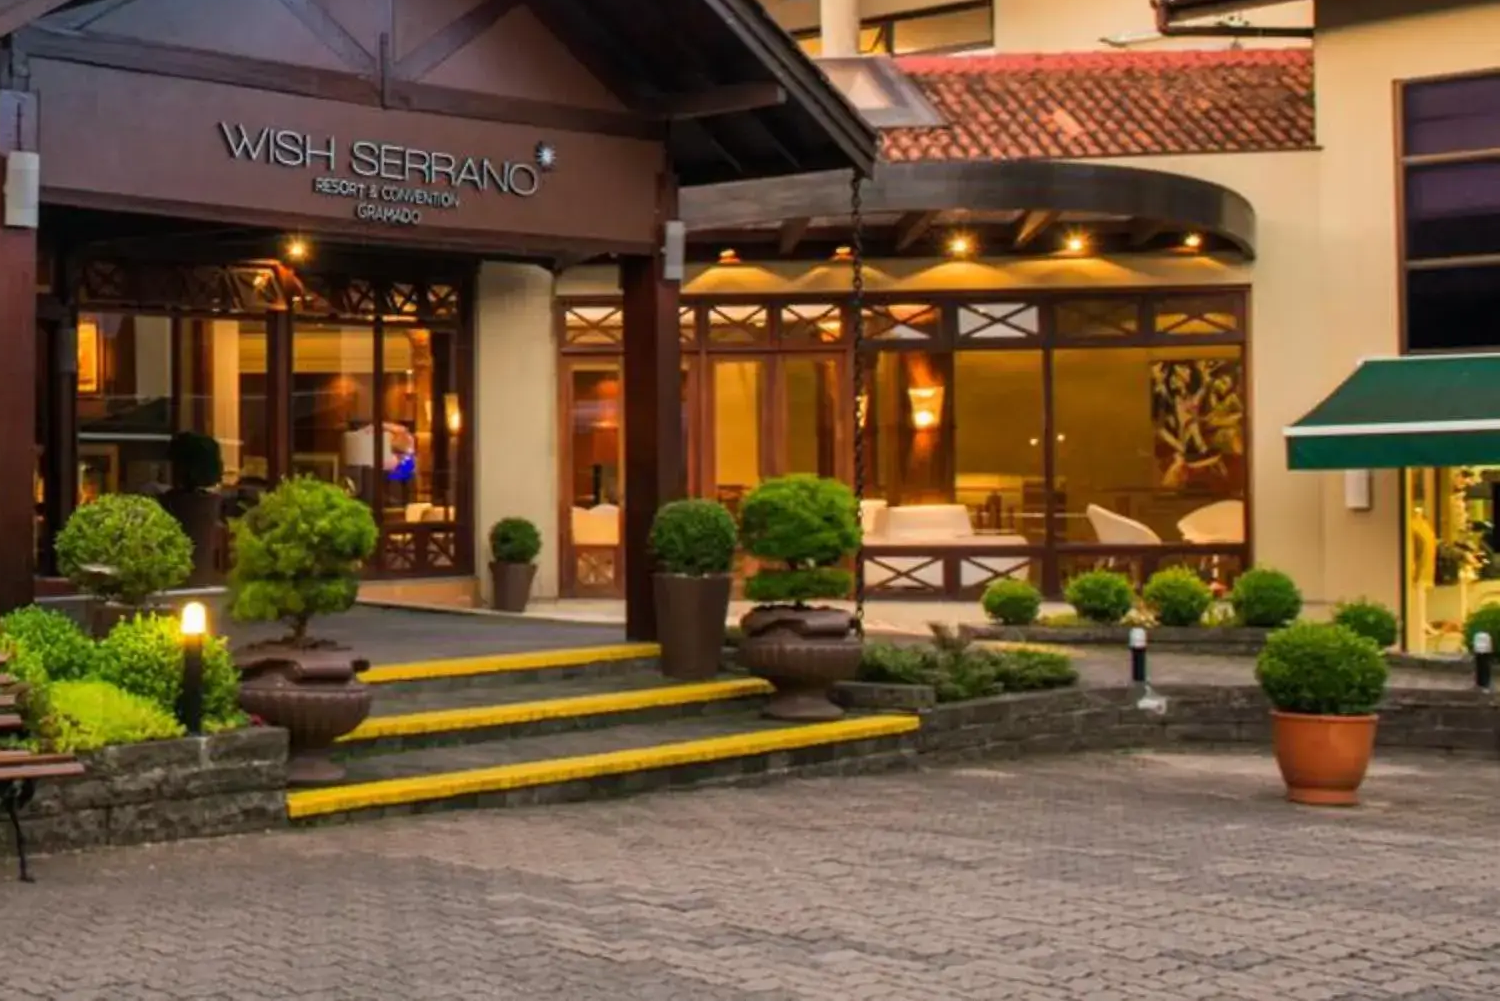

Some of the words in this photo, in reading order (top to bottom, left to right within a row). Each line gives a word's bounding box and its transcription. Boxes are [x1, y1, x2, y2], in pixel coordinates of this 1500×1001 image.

[218, 121, 336, 170] WISH
[350, 140, 540, 197] SERRANO
[314, 177, 366, 198] RESORT
[369, 184, 378, 198] &
[381, 185, 460, 208] CONVENTION
[357, 202, 422, 225] GRAMADO
